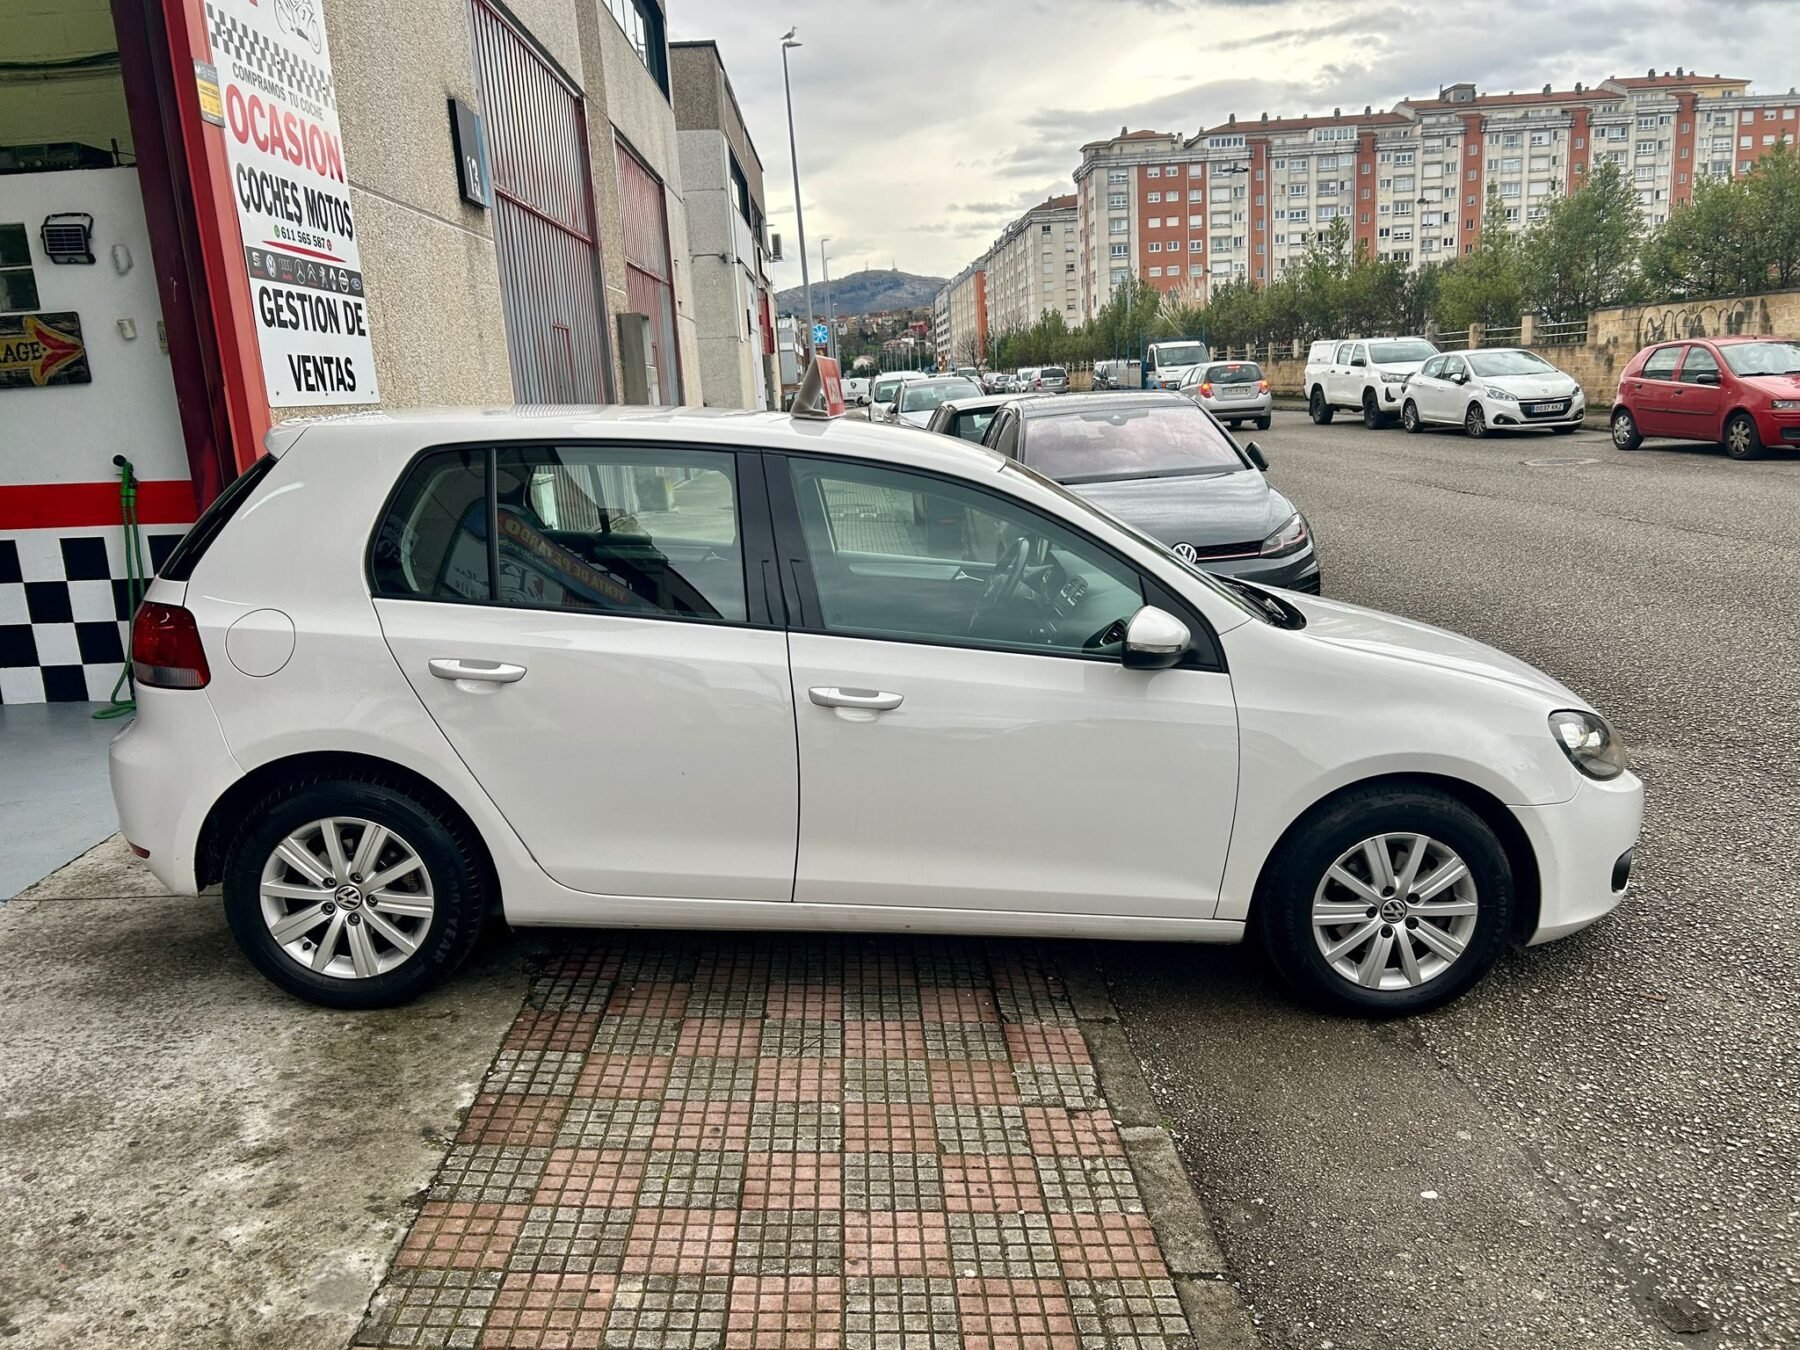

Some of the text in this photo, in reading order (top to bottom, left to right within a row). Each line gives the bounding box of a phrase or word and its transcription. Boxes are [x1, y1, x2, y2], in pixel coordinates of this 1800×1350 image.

[232, 62, 286, 101] COMPRAMOS
[288, 91, 298, 108] TU
[300, 97, 324, 121] COCHE
[225, 83, 344, 184] OCASION
[236, 162, 354, 240] COCHES MOTOS
[281, 227, 326, 249] 611 565 587
[258, 285, 367, 337] GESTION DE
[0, 342, 44, 364] AGE
[287, 354, 357, 393] VENTAS
